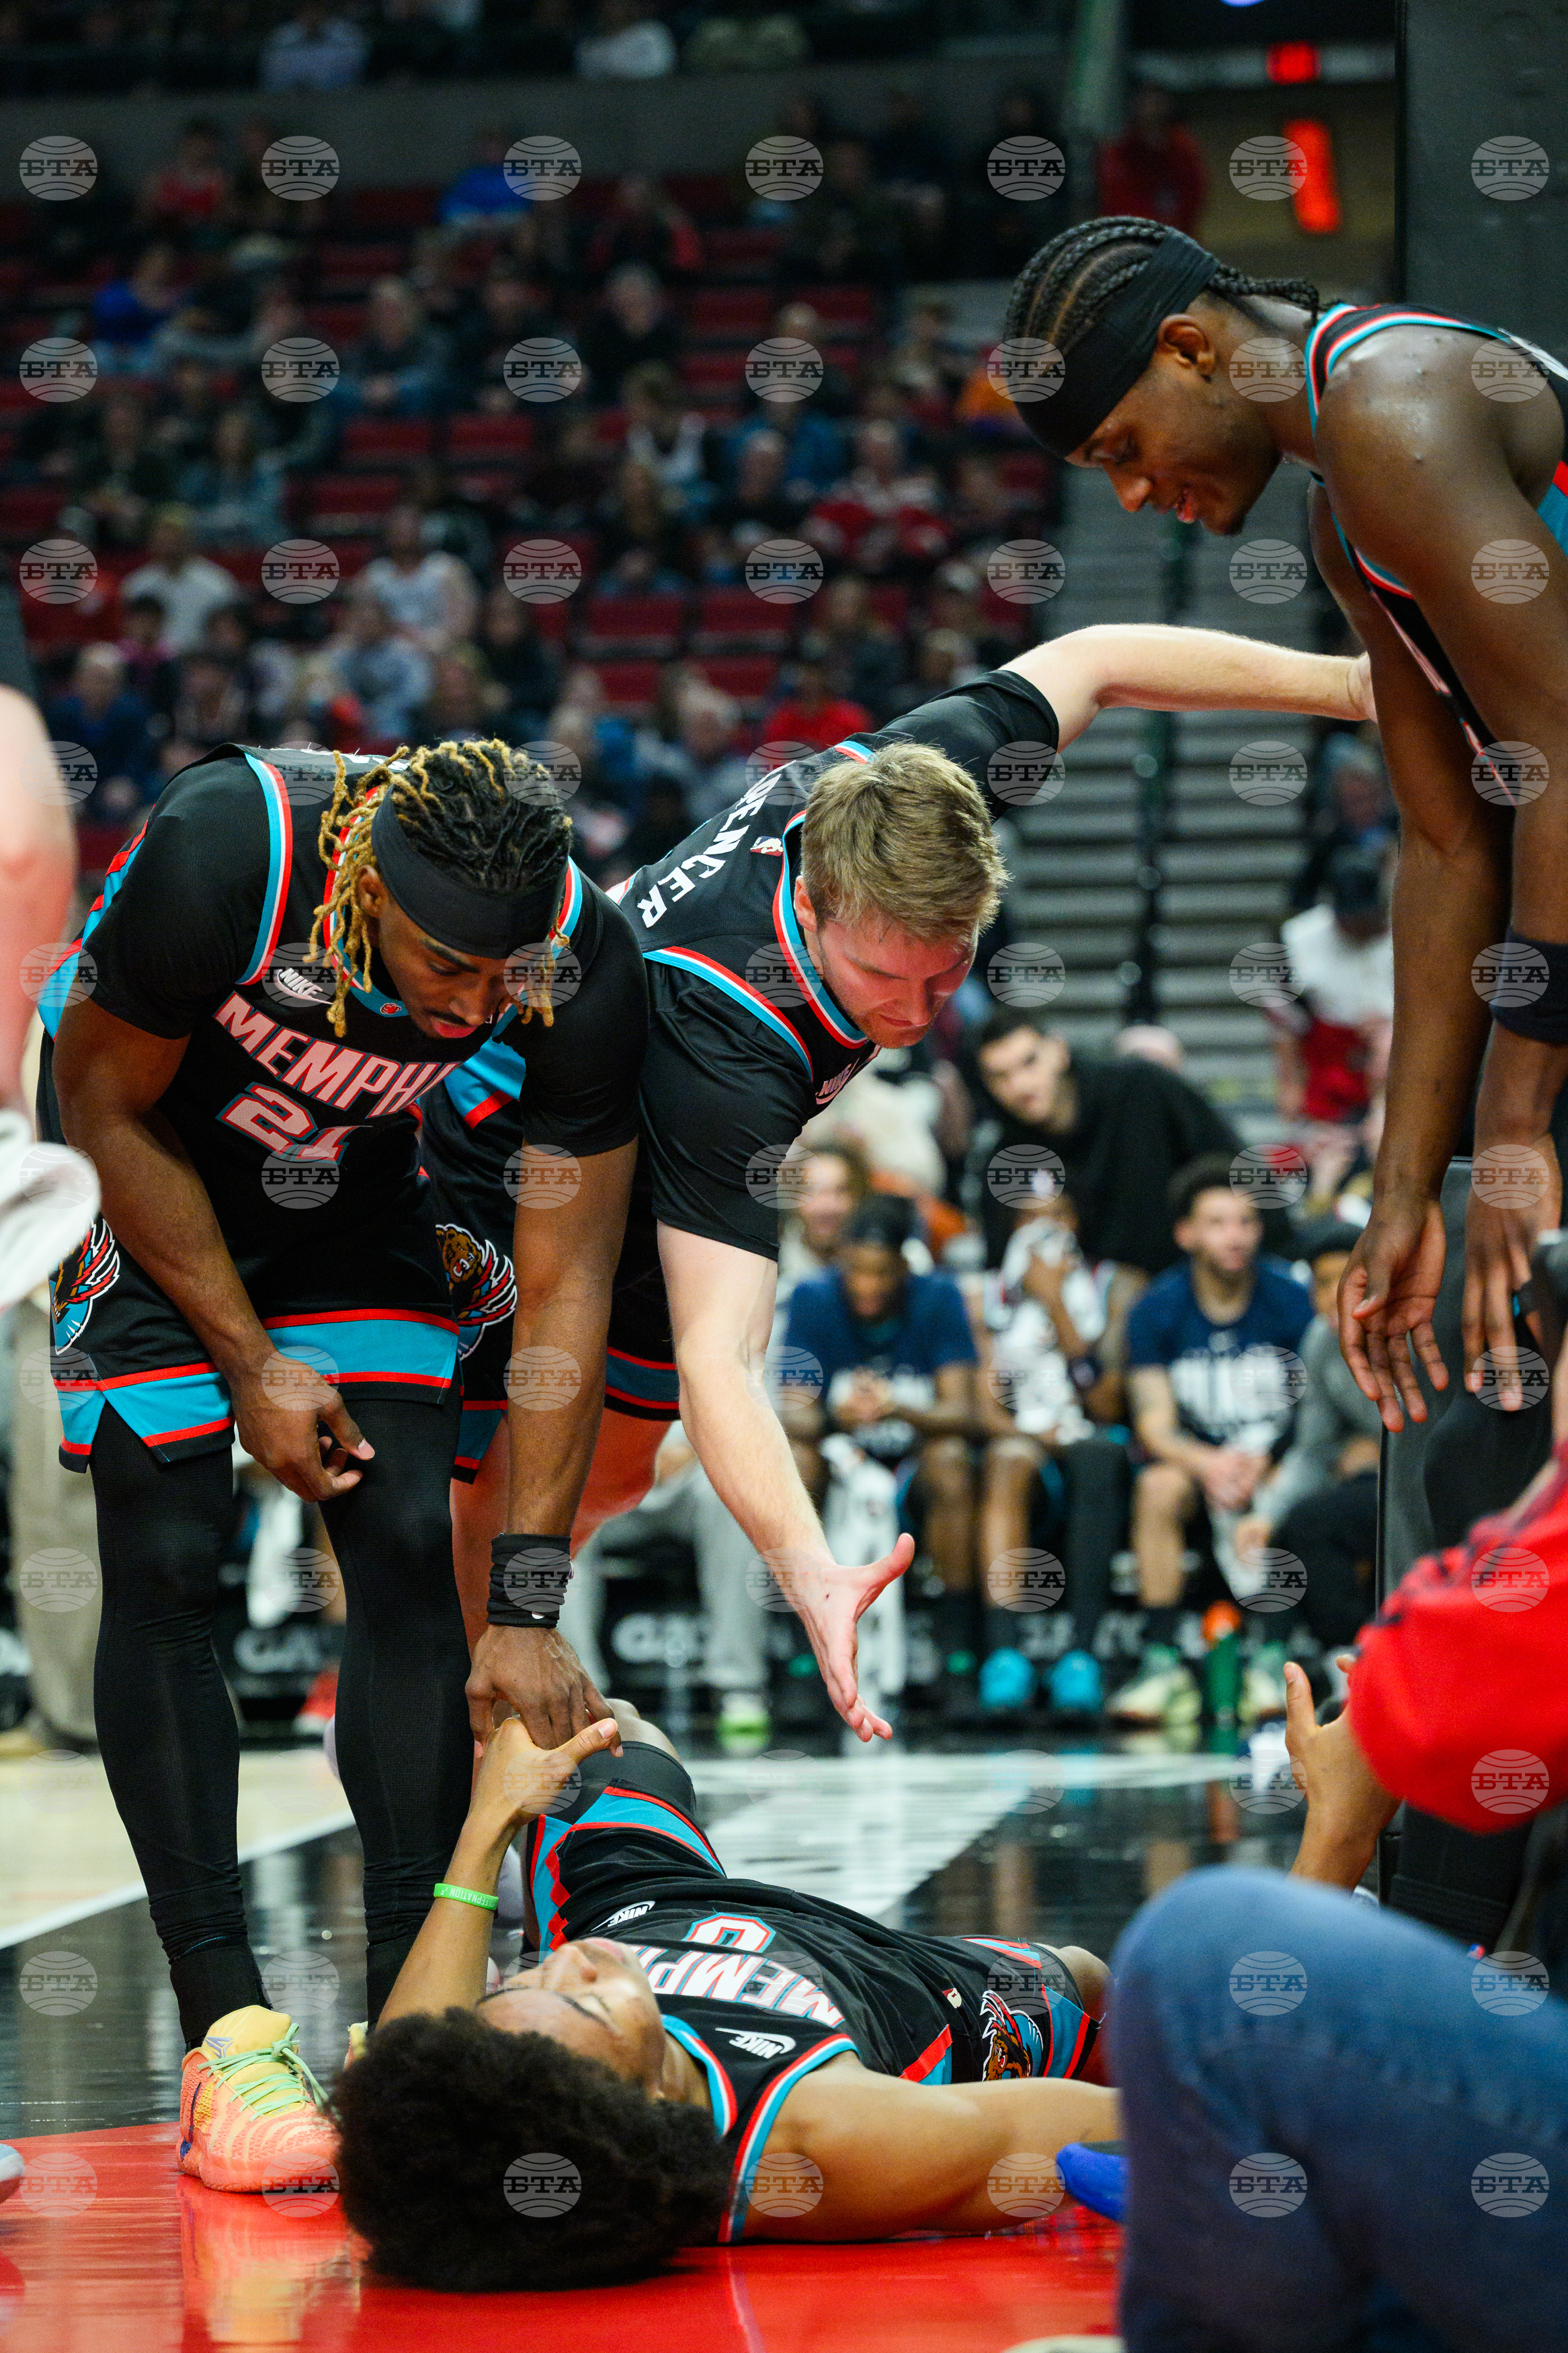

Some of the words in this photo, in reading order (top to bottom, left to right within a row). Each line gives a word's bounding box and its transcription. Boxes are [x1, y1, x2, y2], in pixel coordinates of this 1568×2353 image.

[636, 760, 797, 928] PENCER
[280, 967, 323, 995] NIKE
[608, 1905, 648, 1927] NIKE
[729, 2036, 783, 2059] NIKE
